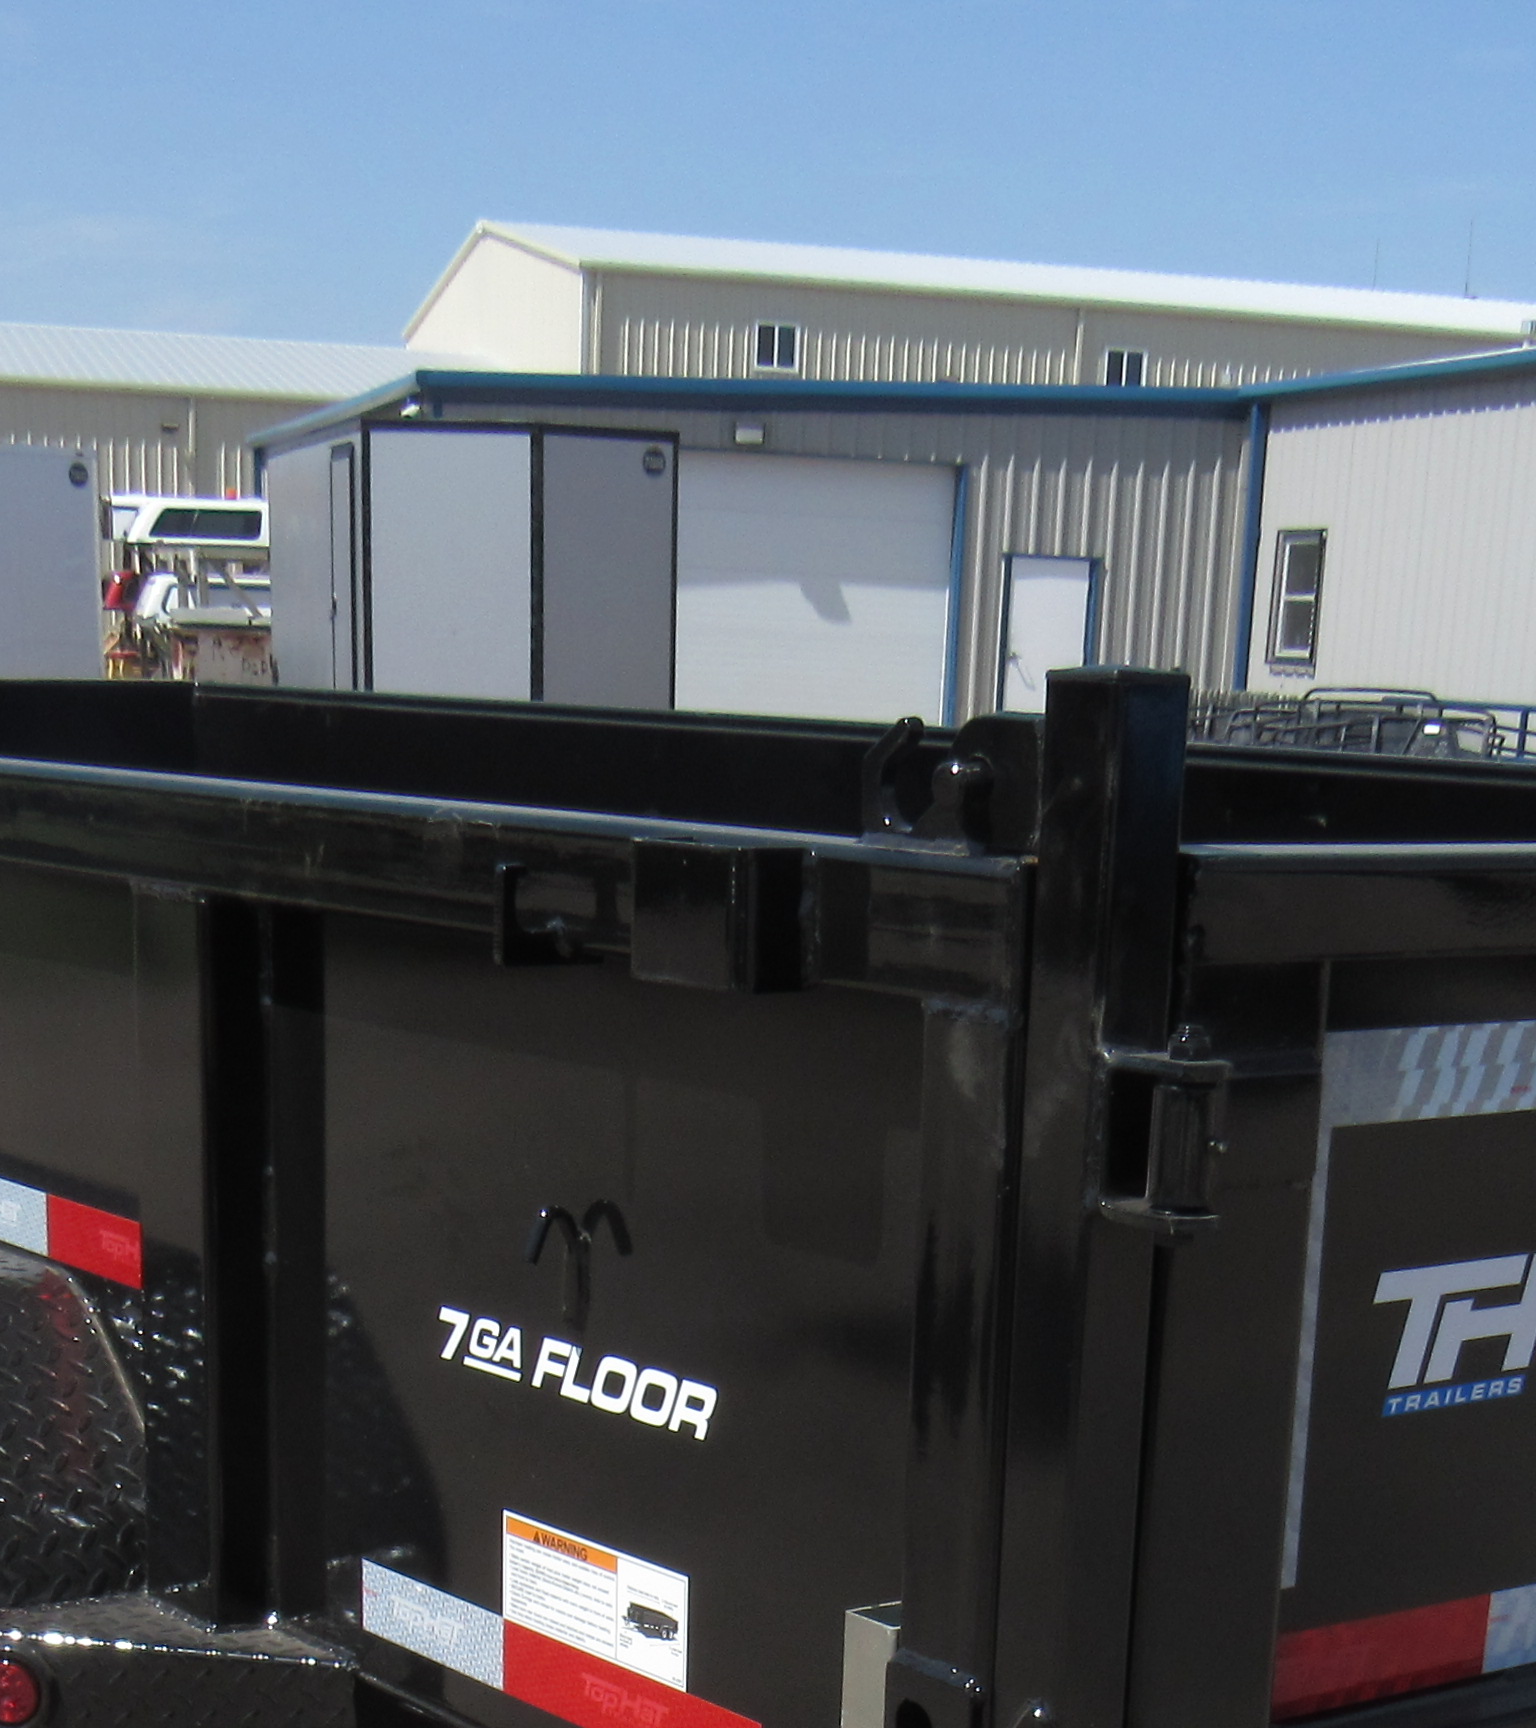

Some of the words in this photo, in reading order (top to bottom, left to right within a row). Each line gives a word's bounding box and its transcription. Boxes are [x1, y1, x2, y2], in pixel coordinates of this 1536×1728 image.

[531, 1337, 718, 1441] FLOOR
[1388, 1377, 1522, 1414] TRAILERS
[541, 1533, 588, 1562] WARNING
